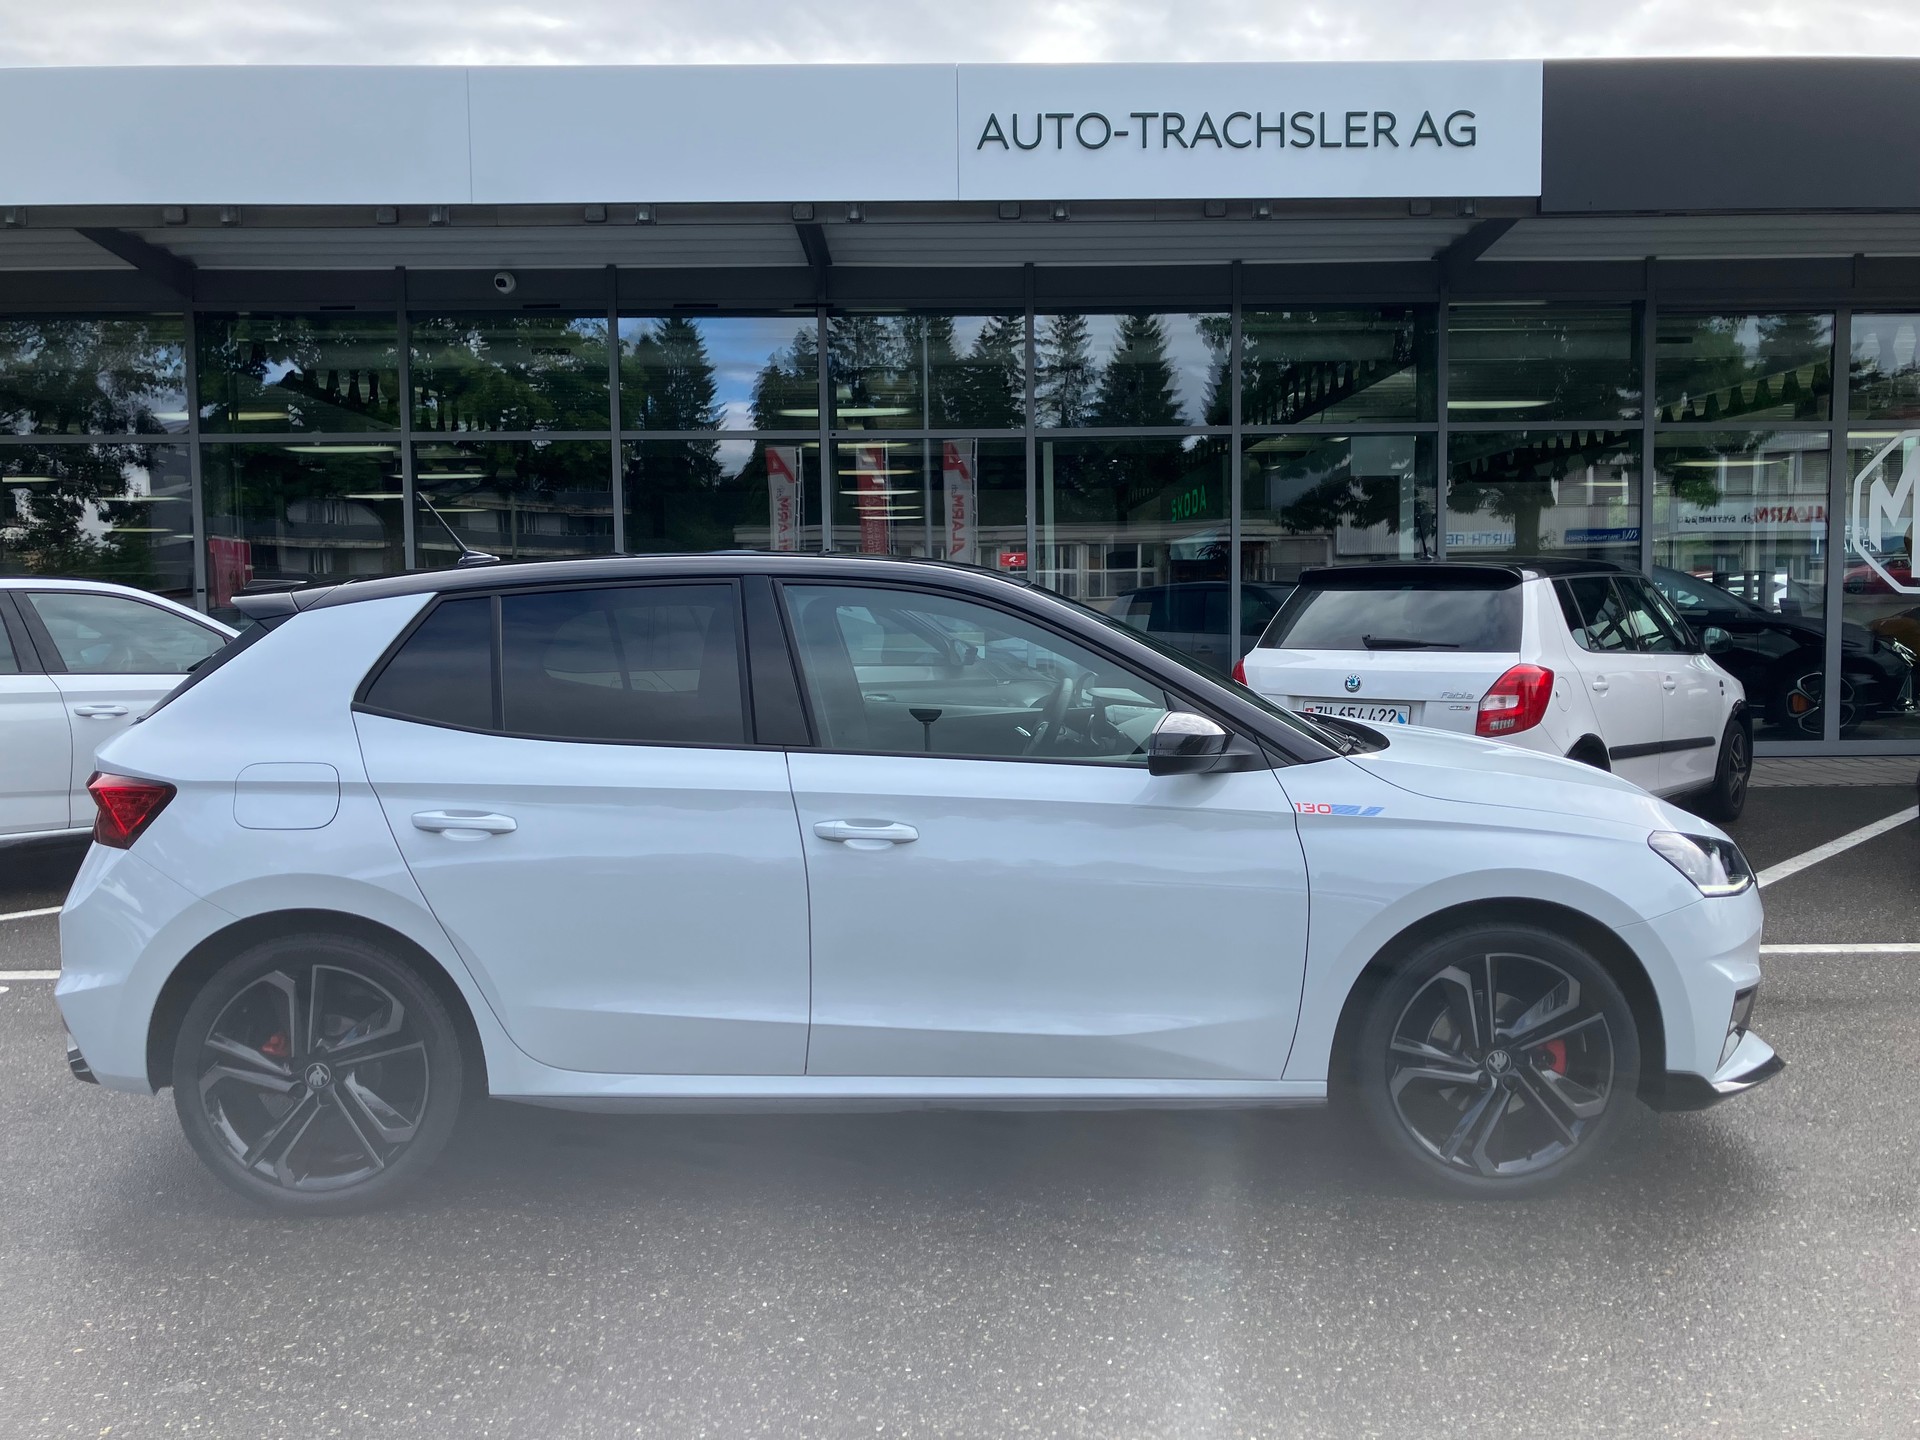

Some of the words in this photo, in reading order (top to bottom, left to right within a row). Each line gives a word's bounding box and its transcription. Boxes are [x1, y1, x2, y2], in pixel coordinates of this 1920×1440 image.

[977, 111, 1400, 150] AUTO-TRACHSLER
[1410, 110, 1477, 148] AG
[1294, 802, 1332, 814] 130
